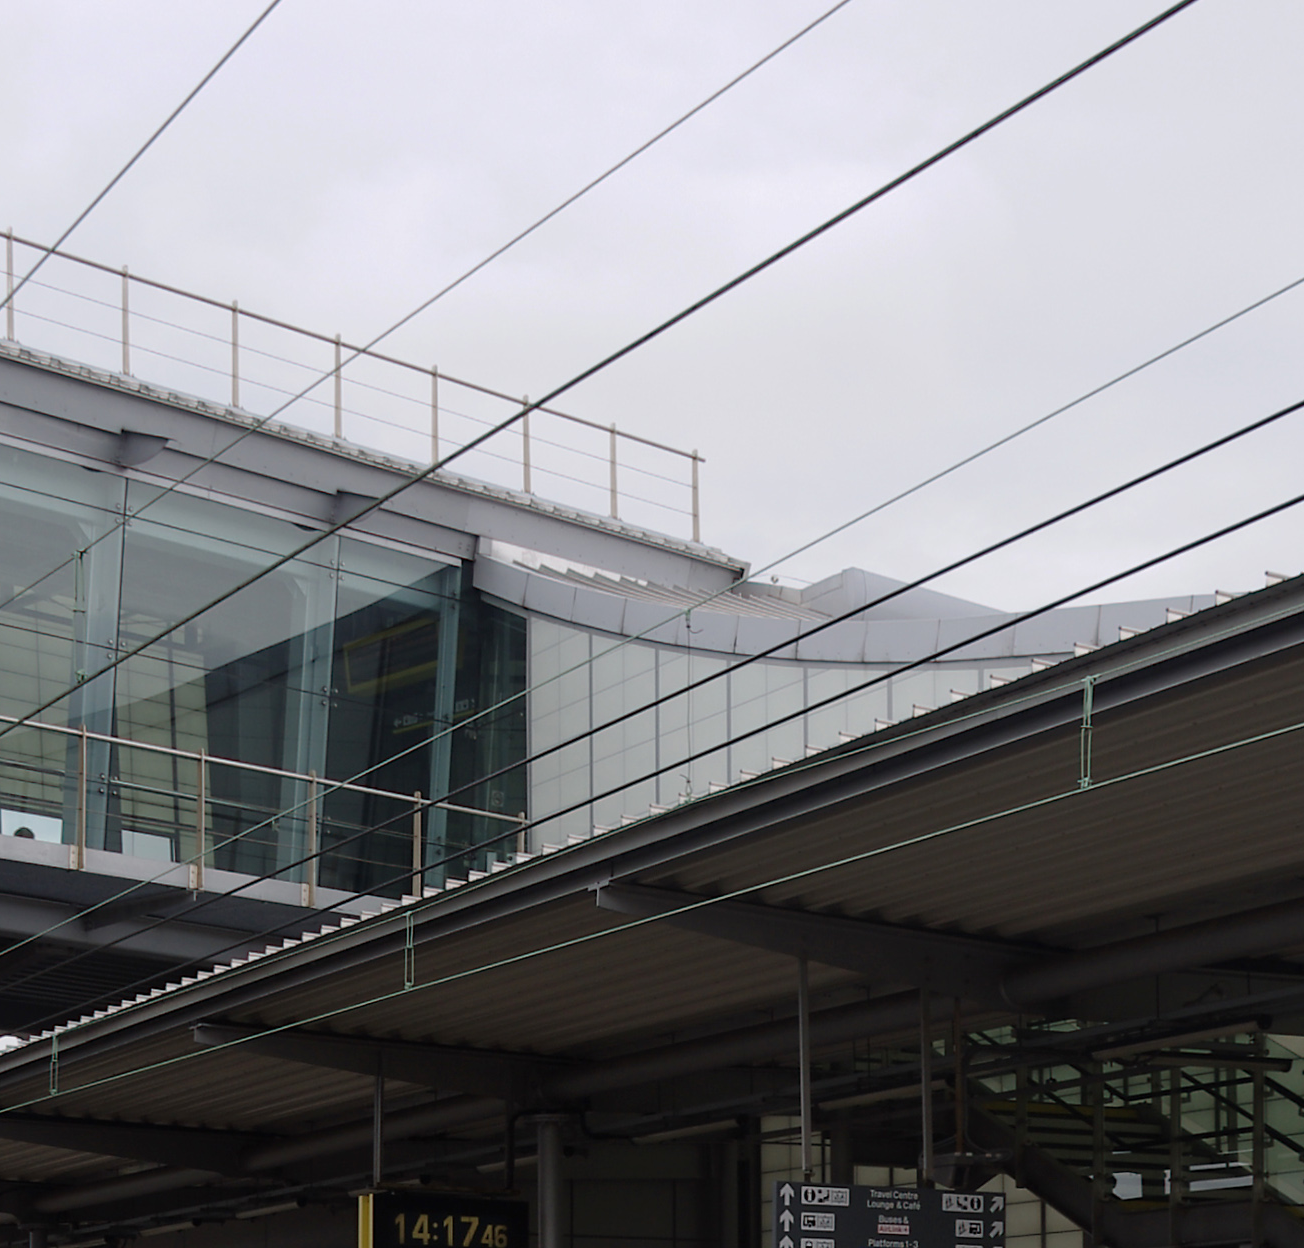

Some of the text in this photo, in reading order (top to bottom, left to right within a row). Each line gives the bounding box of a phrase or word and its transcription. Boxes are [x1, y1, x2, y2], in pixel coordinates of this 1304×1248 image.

[869, 1189, 919, 1200] Travel Centre
[867, 1199, 895, 1210] Lounge
[896, 1200, 902, 1209] &
[878, 1214, 909, 1224] Buses &
[394, 1212, 480, 1248] 14:17
[868, 1238, 905, 1248] Platforms
